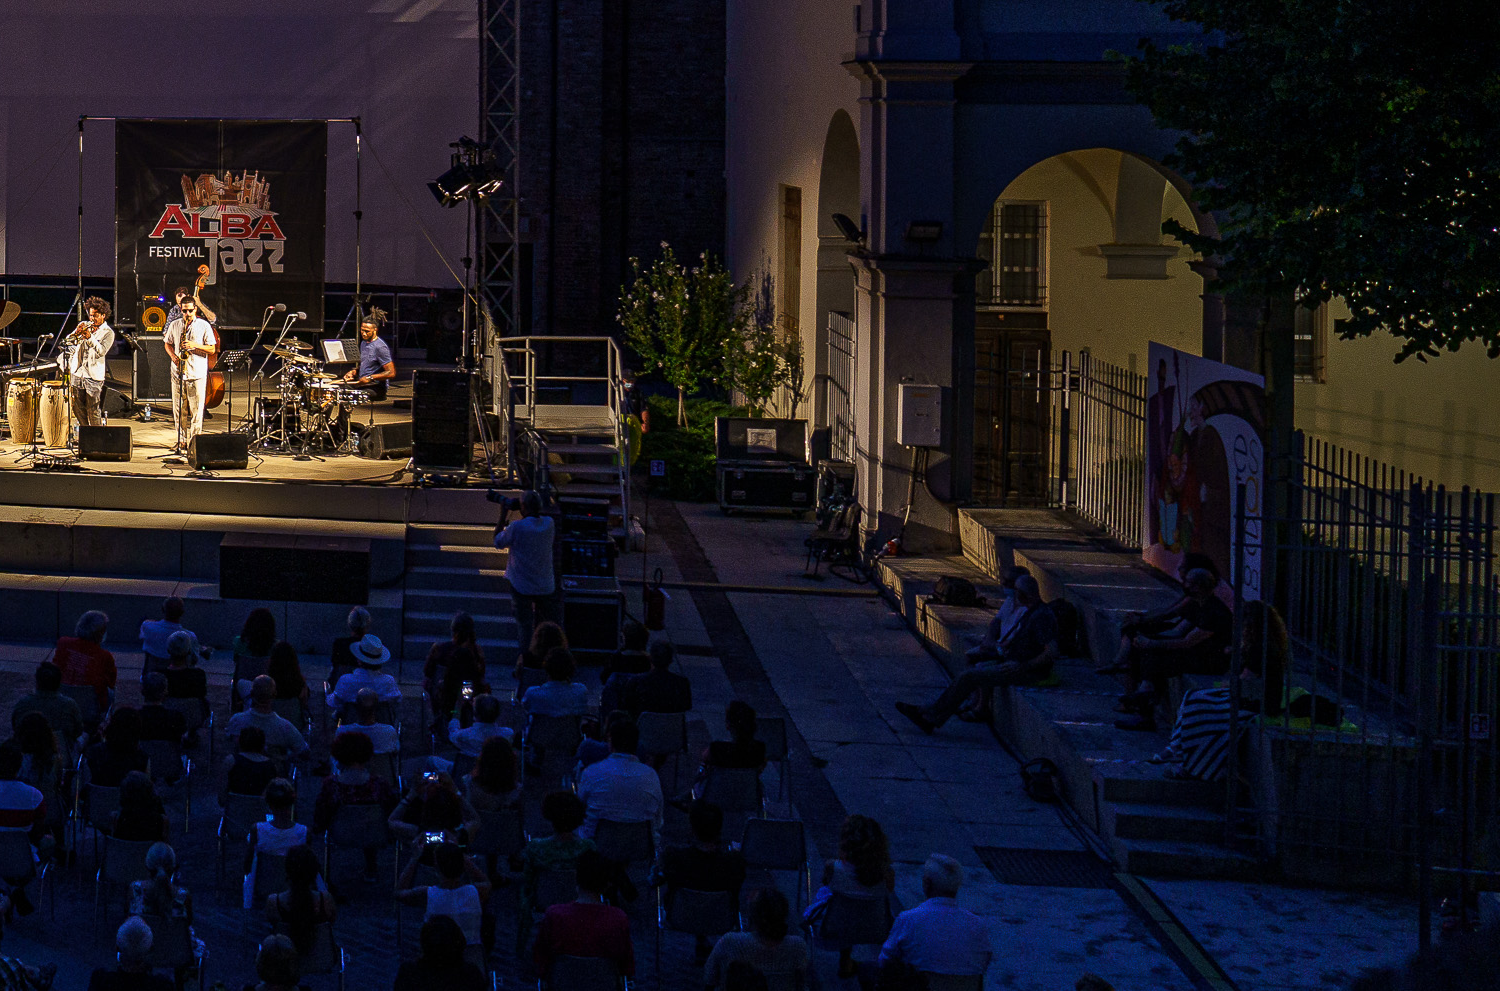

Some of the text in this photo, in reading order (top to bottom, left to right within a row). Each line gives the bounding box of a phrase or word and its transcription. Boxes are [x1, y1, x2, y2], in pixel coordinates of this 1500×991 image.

[148, 204, 286, 240] ALBA
[149, 221, 284, 285] FESTIVAL jazz
